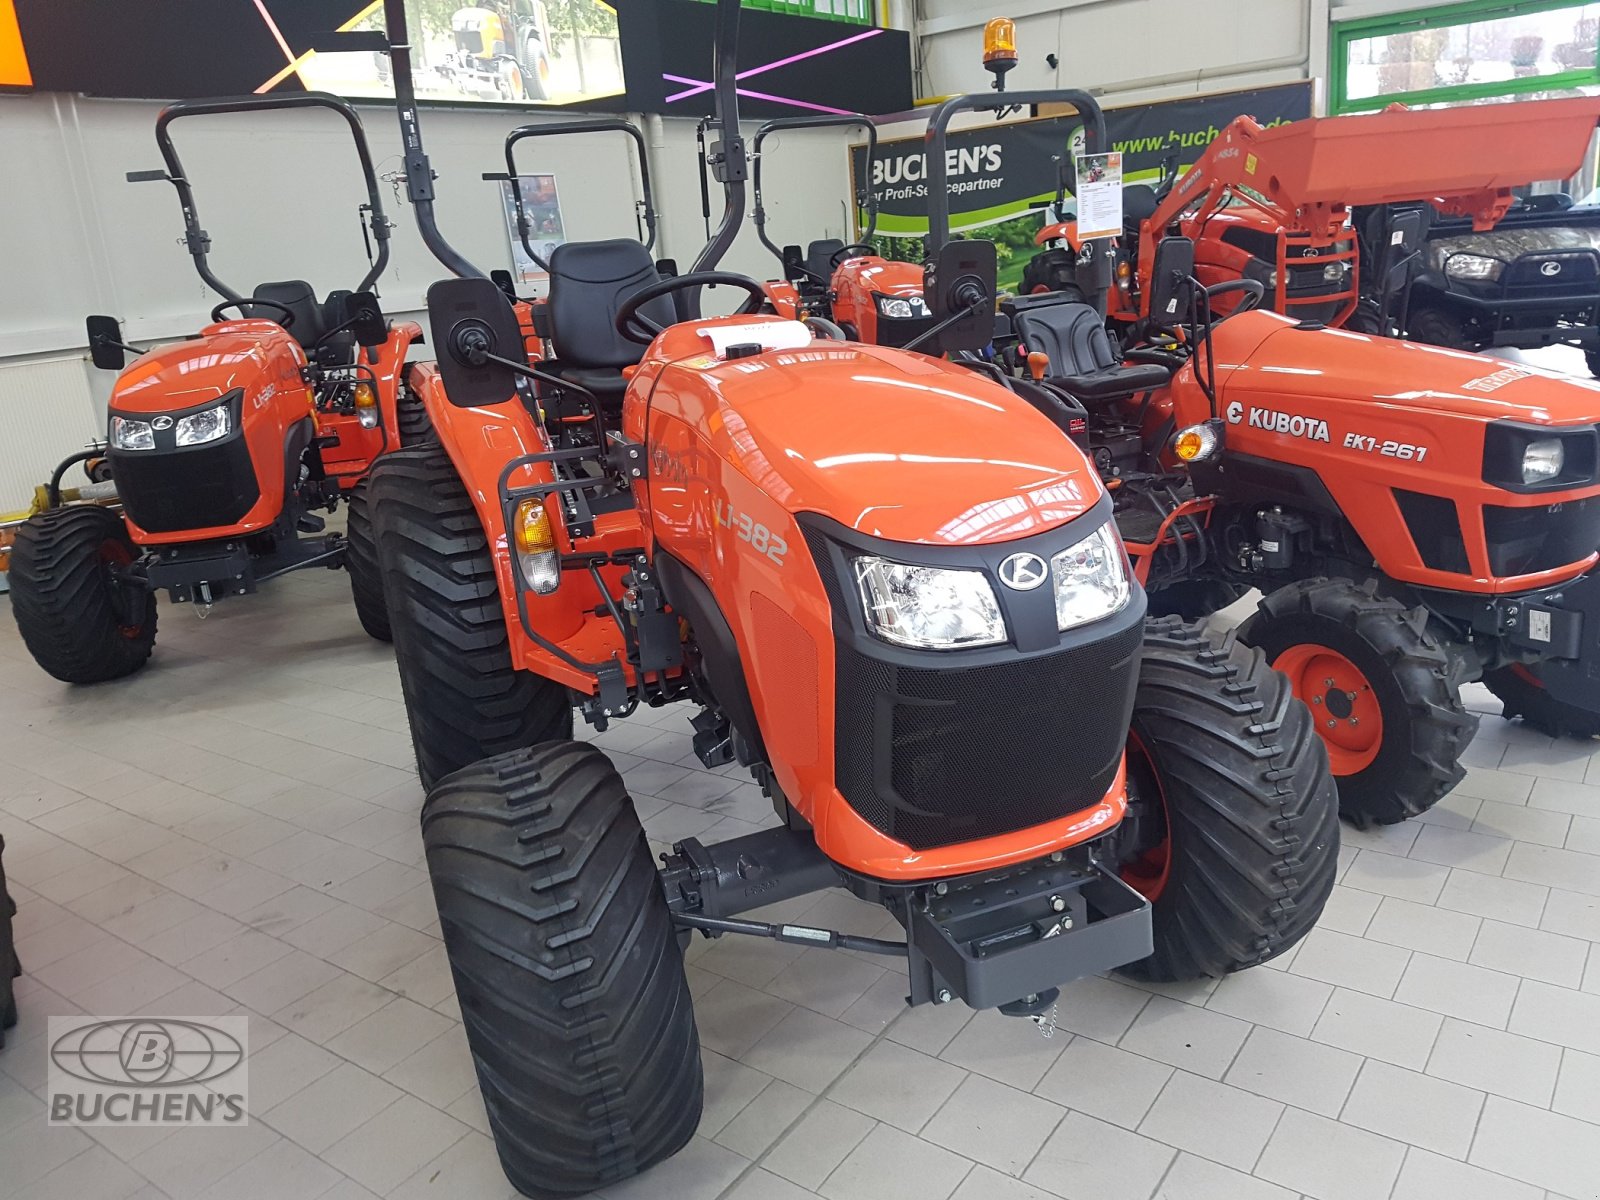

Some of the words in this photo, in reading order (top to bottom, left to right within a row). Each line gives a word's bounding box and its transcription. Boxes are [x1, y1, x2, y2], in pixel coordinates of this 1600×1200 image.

[1249, 406, 1330, 443] KUBOTA
[1343, 432, 1427, 462] EK1-261
[716, 498, 788, 567] L1-382
